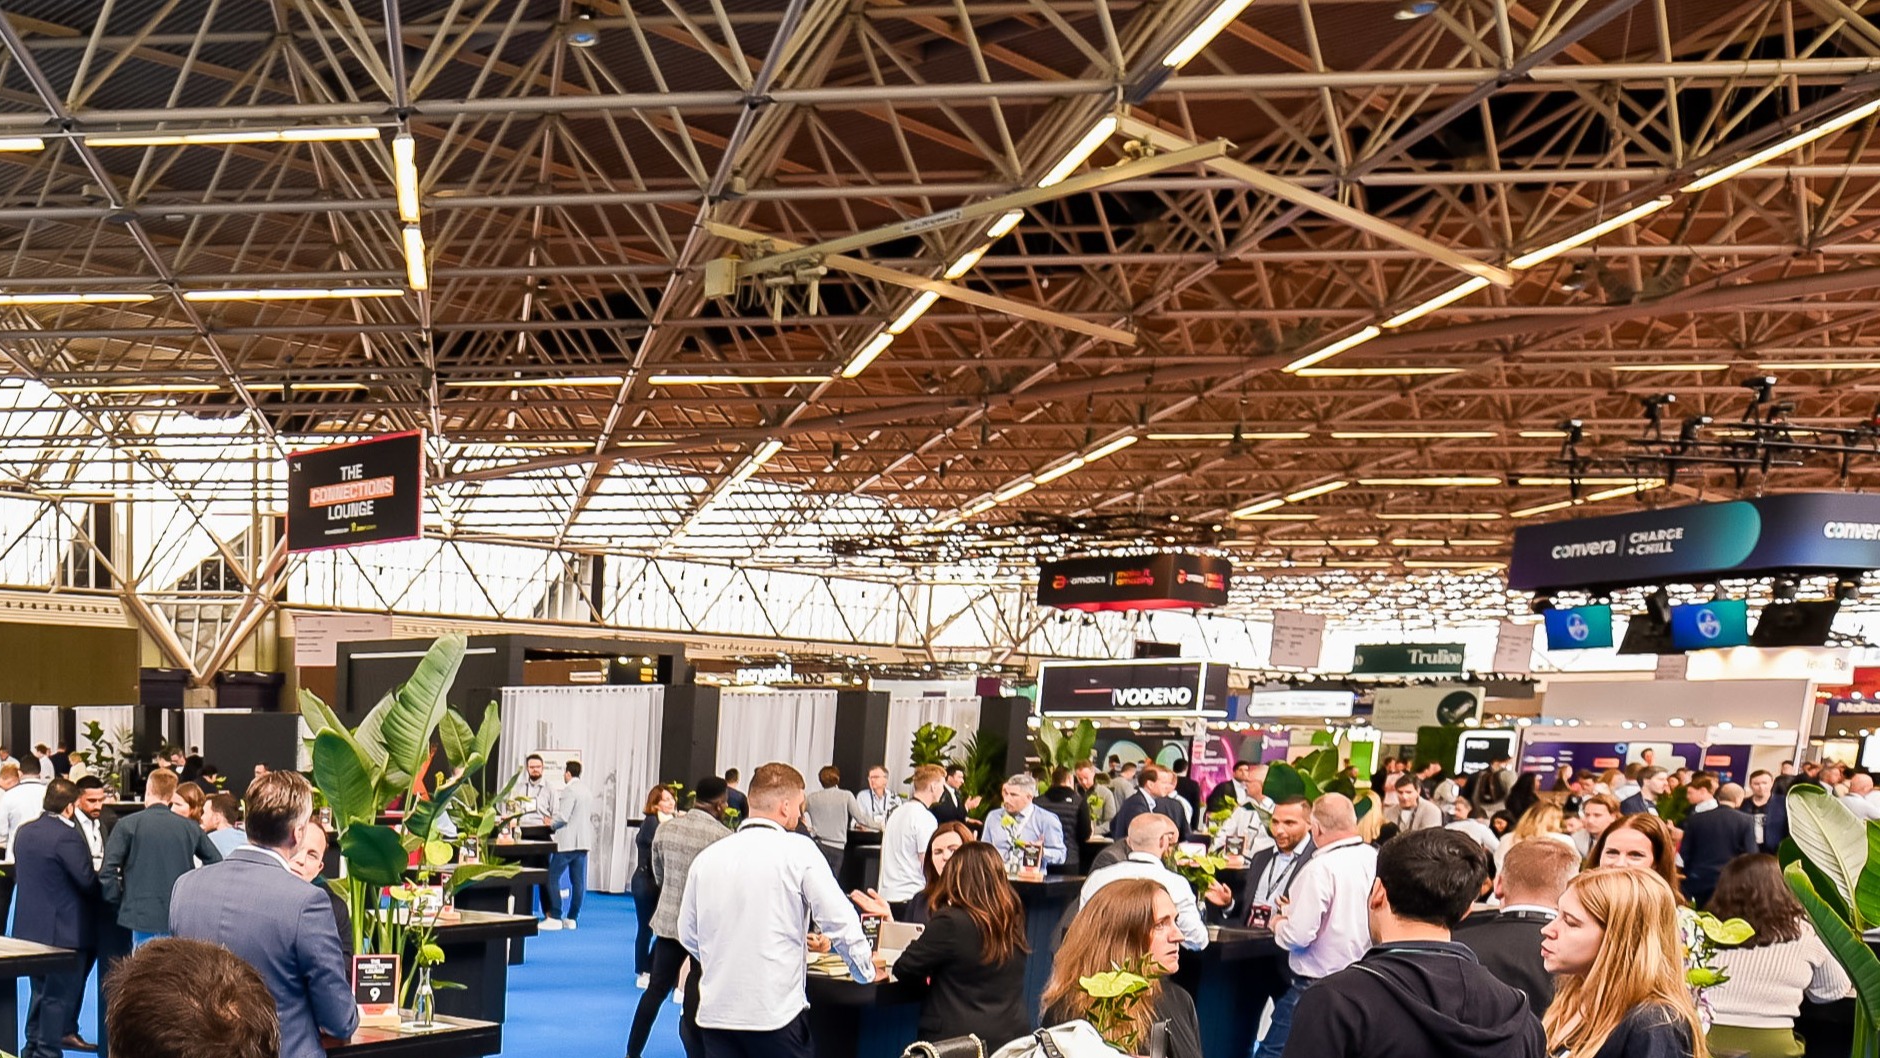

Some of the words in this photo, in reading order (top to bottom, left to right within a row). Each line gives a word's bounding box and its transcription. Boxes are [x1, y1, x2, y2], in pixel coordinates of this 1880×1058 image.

[340, 463, 363, 481] THE
[311, 478, 393, 504] CONNECTIONS
[327, 500, 374, 520] LOUNGE
[1823, 520, 1880, 541] conver
[1551, 540, 1616, 560] convera
[1629, 527, 1684, 544] CHARGE
[1115, 687, 1192, 706] VODENO
[369, 987, 380, 1001] 9
